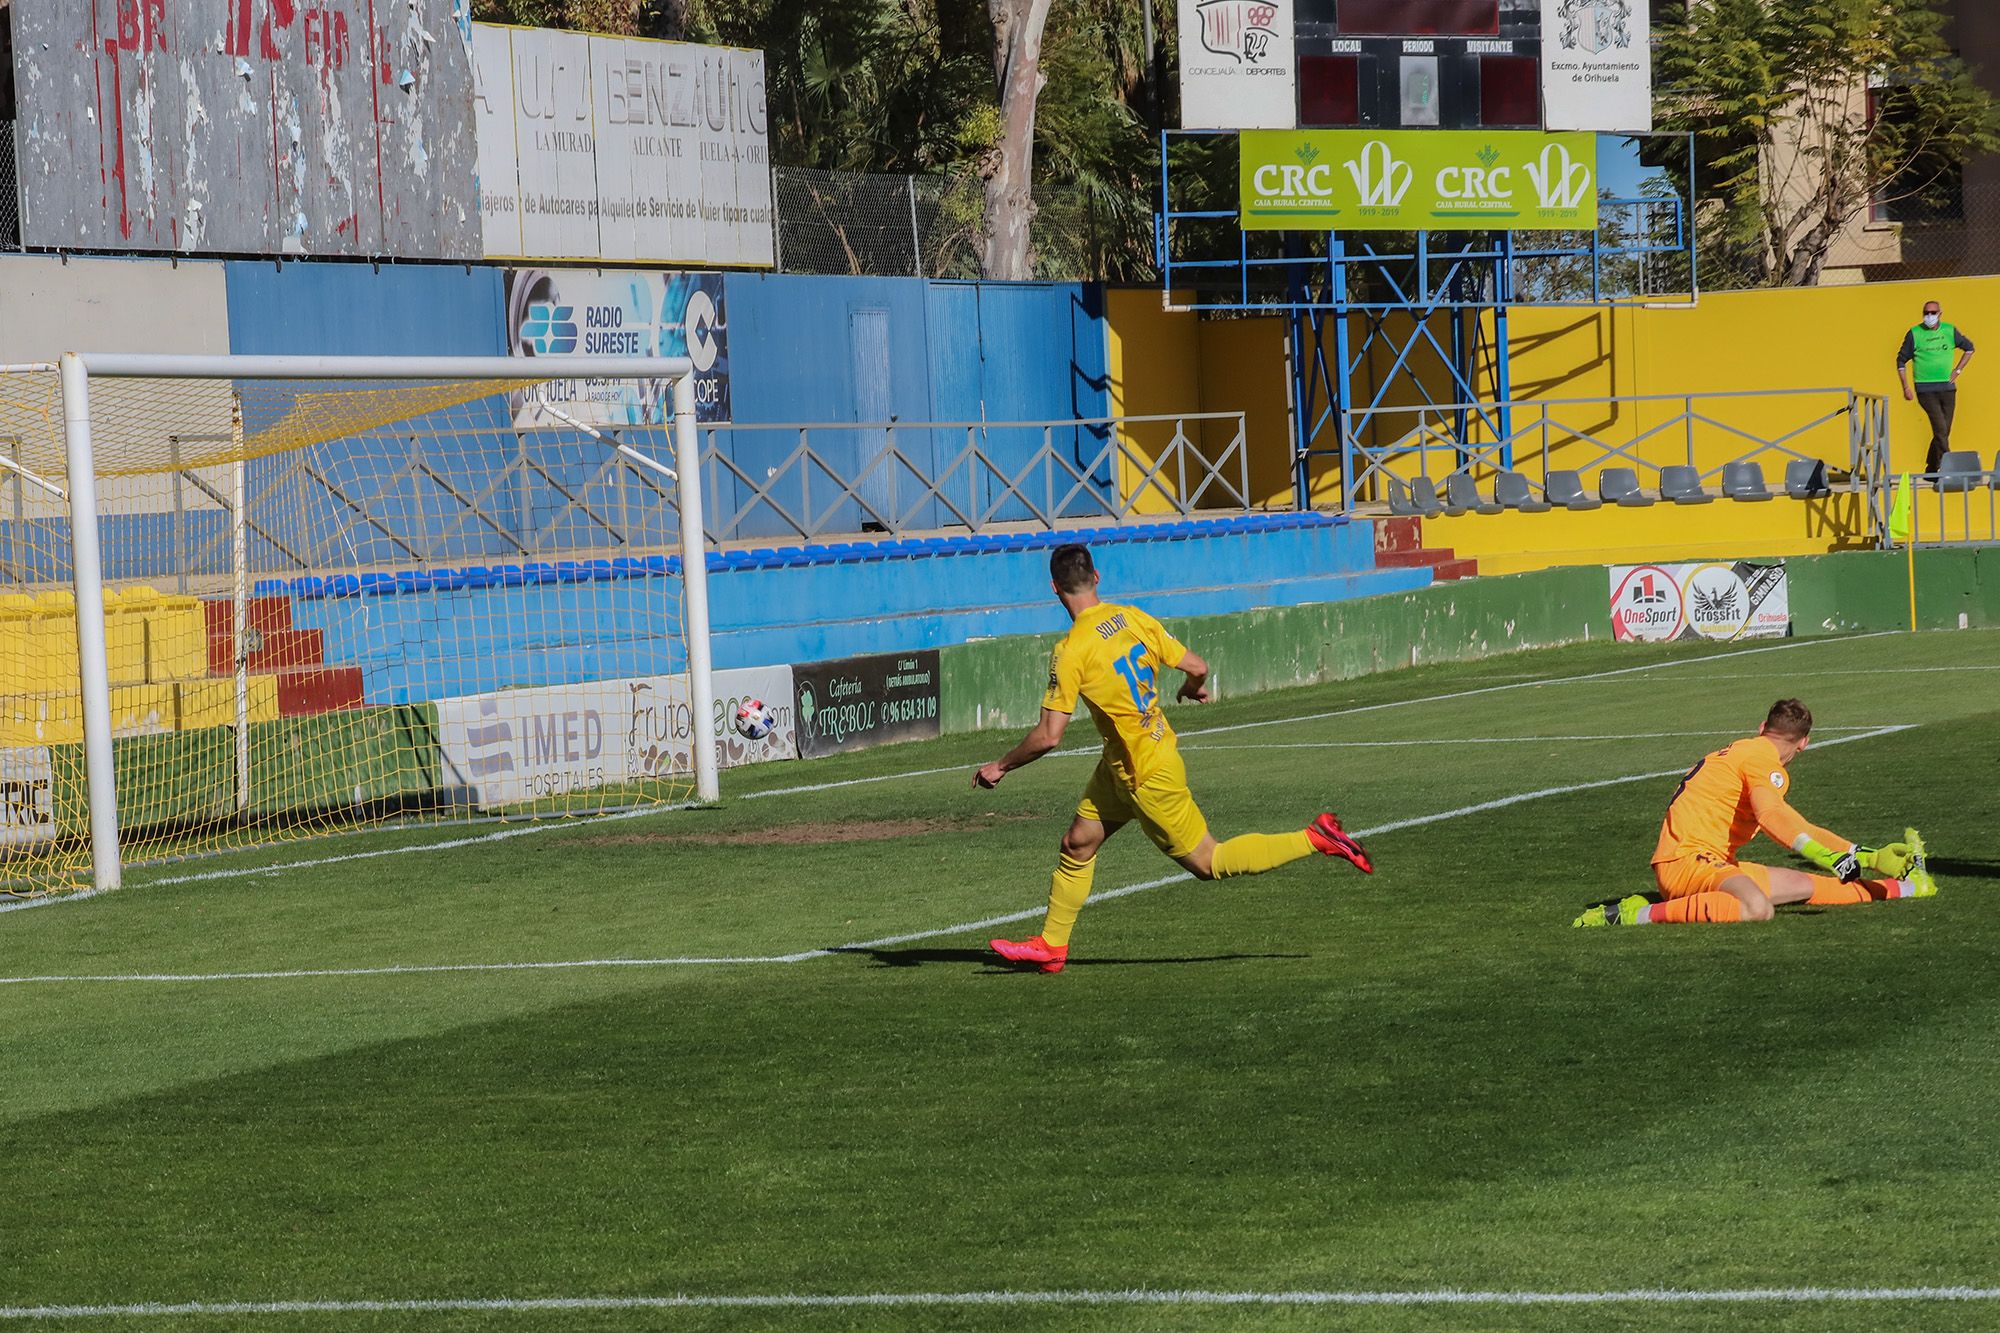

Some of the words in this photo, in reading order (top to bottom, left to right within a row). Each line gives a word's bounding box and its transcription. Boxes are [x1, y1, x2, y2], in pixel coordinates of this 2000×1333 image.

[1331, 40, 1362, 53] LOCAL
[1402, 40, 1434, 53] PERIODO
[1466, 40, 1513, 53] VISITANTE
[1246, 67, 1286, 76] DEPORTES
[1551, 61, 1580, 71] Excmo.
[1582, 61, 1640, 73] Ayuntamiento
[1571, 74, 1583, 82] de
[1584, 73, 1620, 83] Orihuela
[633, 136, 684, 158] ALICANTE
[1253, 164, 1333, 196] CRC
[1435, 166, 1513, 198] CRC
[538, 193, 586, 216] Autocares
[636, 195, 648, 214] de
[649, 196, 684, 218] Servicio
[686, 198, 697, 219] de
[1254, 199, 1271, 207] CAJA
[1273, 199, 1297, 207] RURAL
[1299, 199, 1333, 207] CENTRAL
[1359, 208, 1377, 217] 1919
[1380, 208, 1400, 217] 2019
[1436, 201, 1453, 209] CAJA
[1454, 201, 1478, 209] RURAL
[1479, 201, 1513, 209] CENTRAL
[586, 306, 623, 328] RADIO
[585, 332, 639, 354] SURESTE
[1624, 606, 1677, 626] OneSport
[1694, 608, 1741, 622] CrossFit
[829, 676, 862, 702] Cafetería
[1112, 643, 1156, 713] 16
[889, 700, 899, 723] 96
[901, 698, 915, 720] 634
[916, 697, 926, 719] 31
[927, 696, 937, 718] 09
[819, 701, 877, 743] TREBOL
[522, 709, 602, 767] IMED
[524, 767, 604, 796] HOSPITALES
